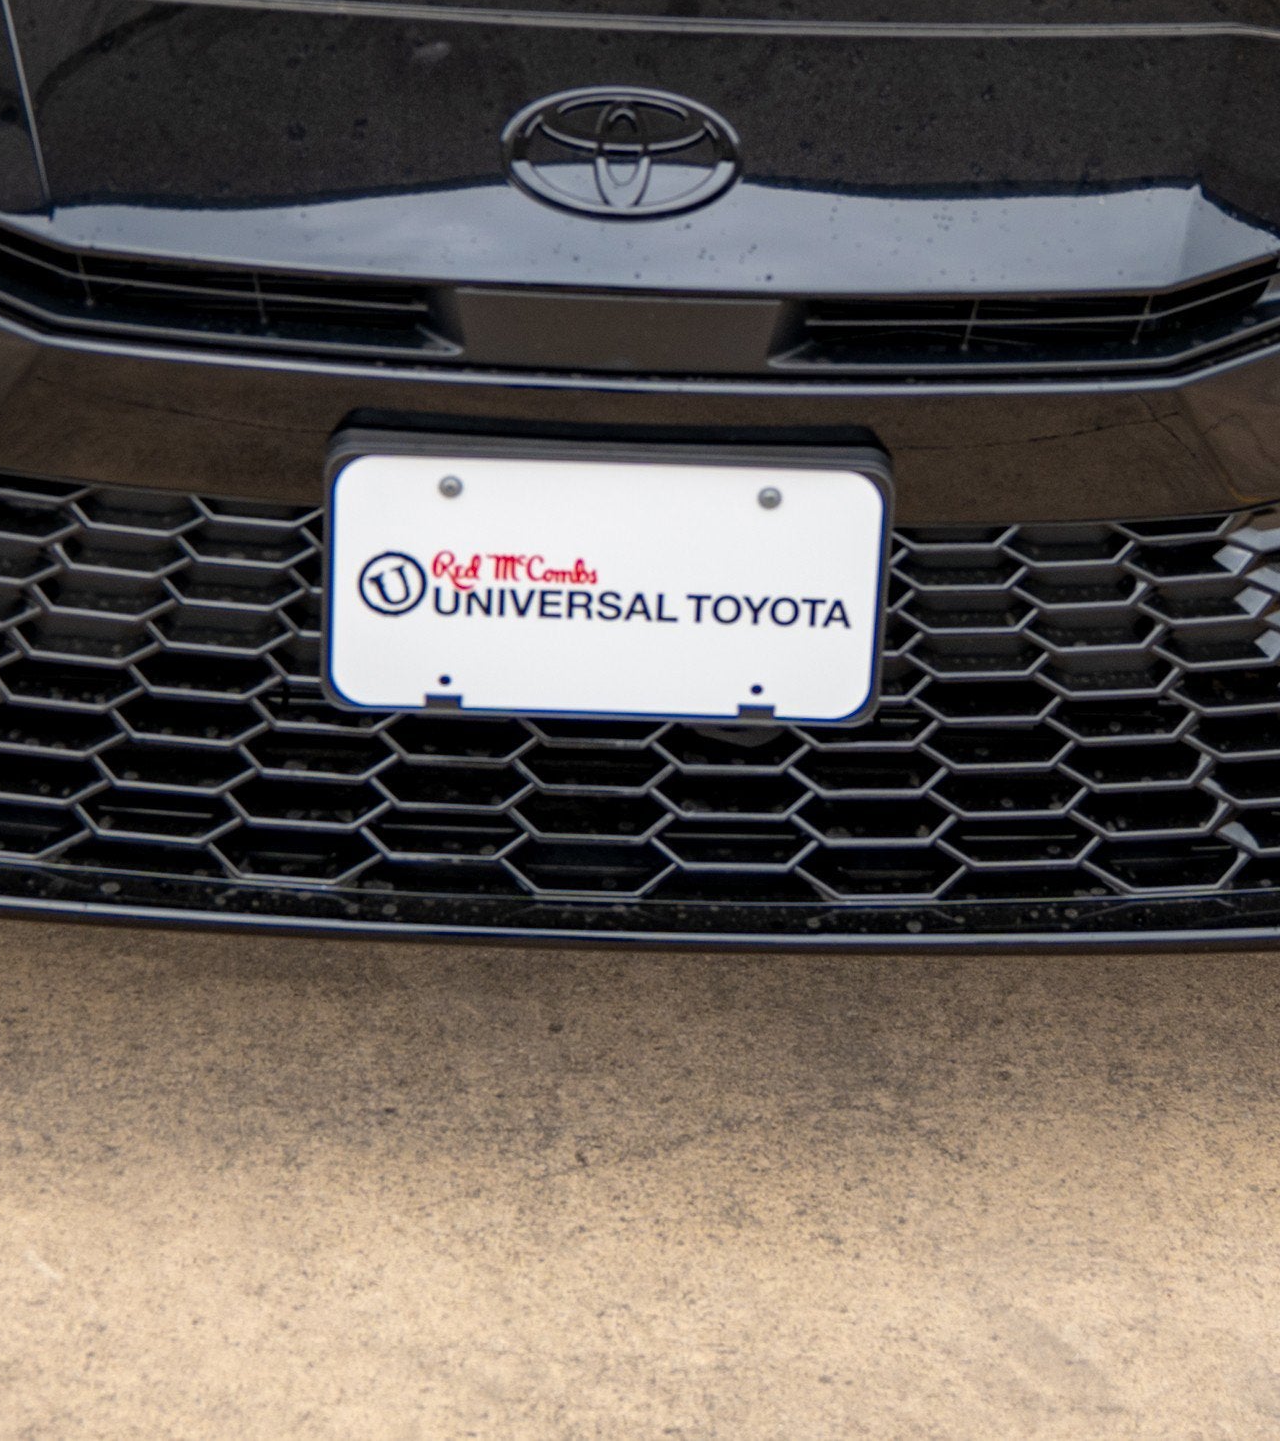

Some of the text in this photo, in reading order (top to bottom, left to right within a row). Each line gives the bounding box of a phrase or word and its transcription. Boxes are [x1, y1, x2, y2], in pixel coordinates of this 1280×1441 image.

[431, 550, 599, 590] Red McCombs
[433, 586, 851, 629] UNIVERSAL TOYOTA
